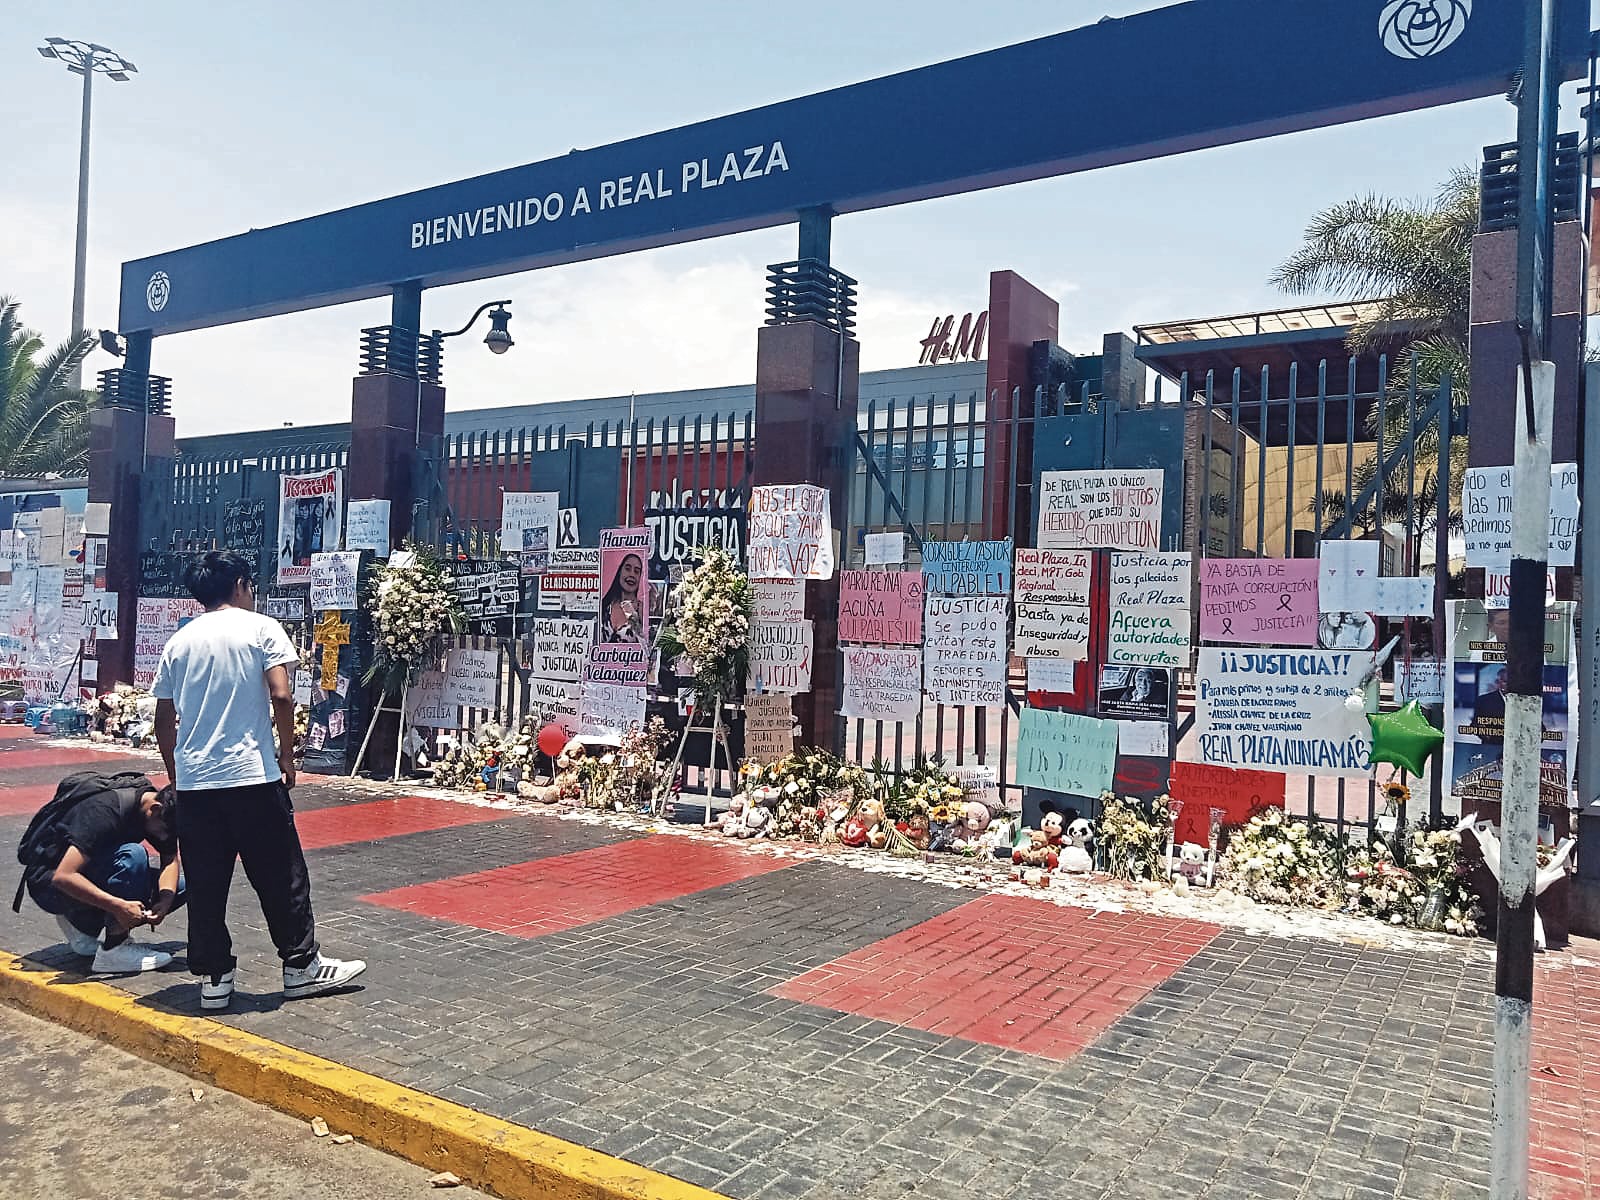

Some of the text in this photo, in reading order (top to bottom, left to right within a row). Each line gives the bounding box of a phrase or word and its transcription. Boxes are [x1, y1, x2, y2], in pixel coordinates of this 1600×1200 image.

[411, 140, 790, 249] BIENVENIDO A REAL PLAZA
[919, 310, 988, 365] H&M
[1045, 481, 1057, 492] DE
[1108, 478, 1118, 487] LO
[784, 488, 797, 511] EL
[1048, 495, 1077, 510] REAL
[1080, 492, 1094, 503] SON
[1097, 492, 1110, 503] LOS
[1468, 491, 1489, 514] las
[764, 514, 789, 539] QUE
[1043, 511, 1085, 531] HERIDOS
[1129, 507, 1140, 518] SU
[602, 530, 649, 548] Harumi
[645, 515, 741, 565] JUSTICIA
[786, 543, 821, 575] VOZ
[1017, 550, 1039, 564] Real
[1111, 553, 1193, 571] Justicia por
[1113, 571, 1131, 584] los
[1207, 563, 1286, 578] YA BASTA DE
[1021, 591, 1086, 603] Responsables
[1118, 590, 1185, 605] Real Plaza
[1204, 582, 1239, 598] TANTA
[841, 599, 885, 617] ACUÑA
[1017, 604, 1089, 626] Basta ya de
[1205, 598, 1257, 616] PEDIMOS
[536, 621, 589, 639] REAL PLAZA
[935, 617, 997, 635] Se pudo
[1111, 610, 1173, 632] Afuera
[1017, 625, 1081, 641] Inseguridad
[1113, 628, 1189, 646] autoridades
[537, 640, 559, 653] NUNCA
[779, 645, 798, 661] DE
[1026, 644, 1060, 657] Abuso
[591, 646, 644, 667] Carbajal
[583, 664, 647, 686] Velasquez
[933, 663, 984, 678] SEÑORES
[536, 684, 566, 699] VIGILIA
[929, 691, 941, 702] DE
[1301, 685, 1311, 695] de
[1313, 684, 1322, 696] 2
[1199, 733, 1237, 764] REAL
